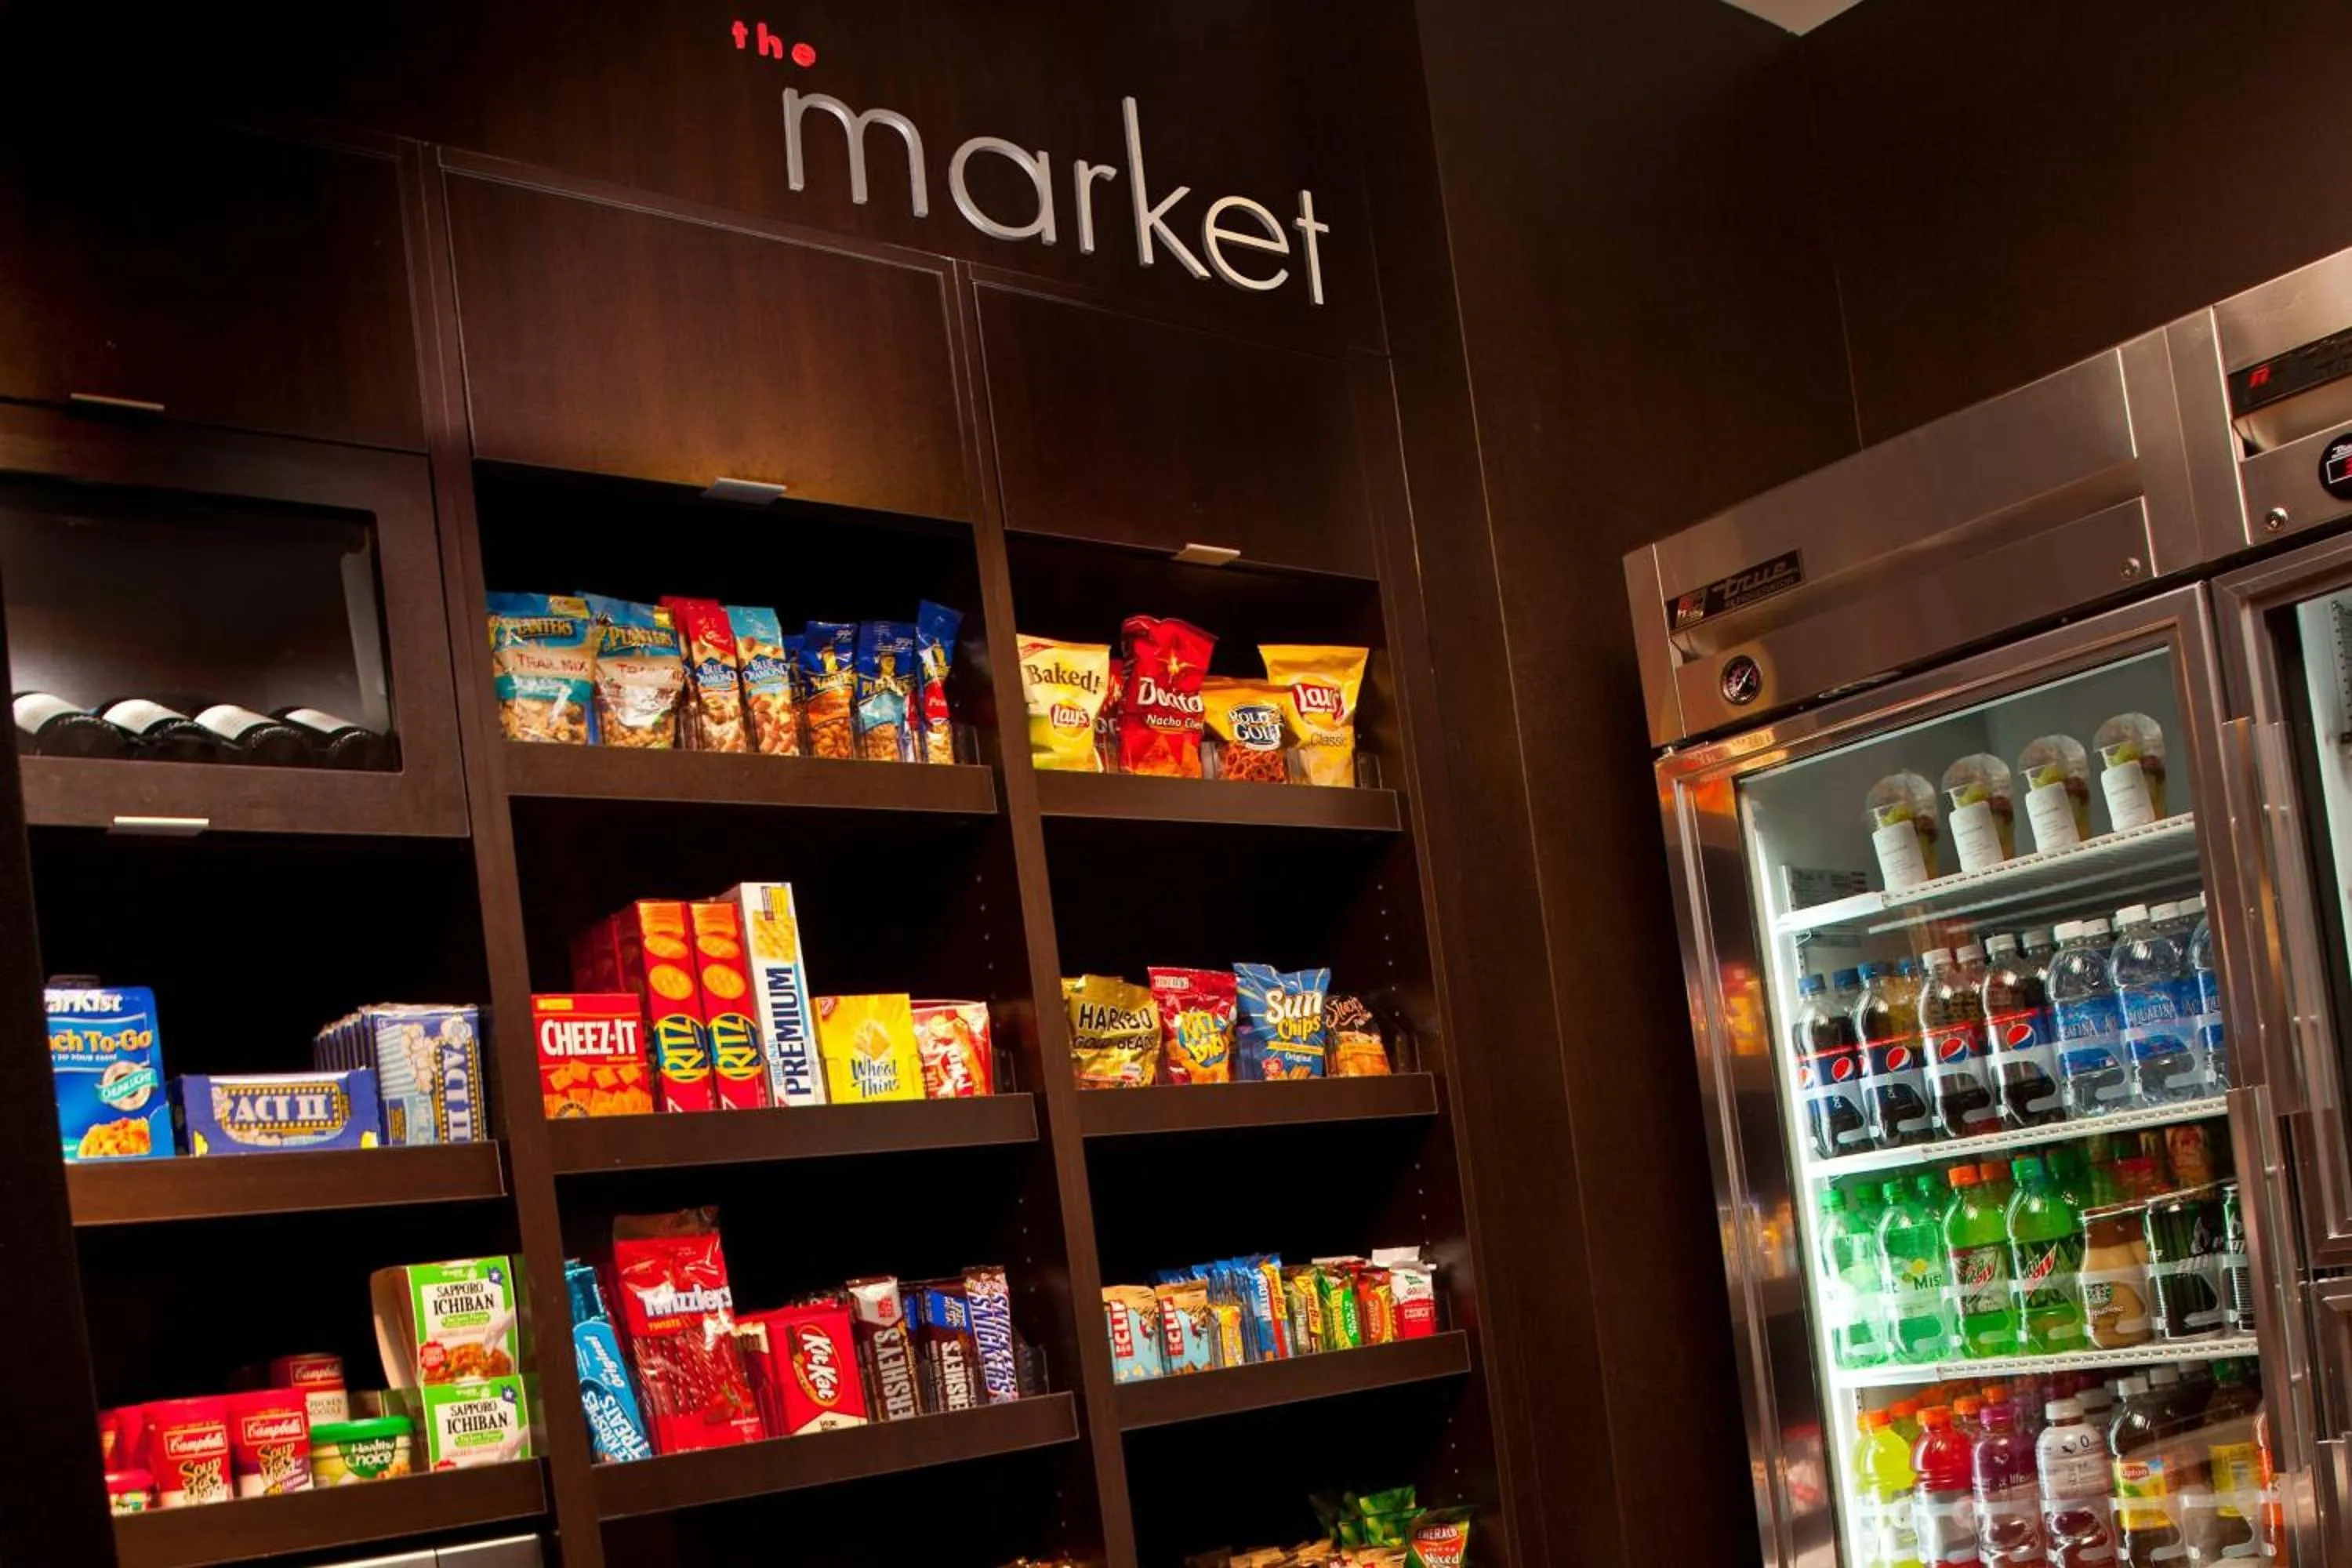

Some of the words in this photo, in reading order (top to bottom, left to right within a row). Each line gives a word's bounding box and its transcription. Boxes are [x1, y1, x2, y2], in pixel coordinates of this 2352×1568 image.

[731, 20, 816, 68] the
[782, 87, 1330, 305] market
[1023, 662, 1099, 695] Baked!
[1137, 677, 1205, 713] Dorito
[1146, 713, 1182, 728] Nacho
[1265, 989, 1323, 1024] Sun
[540, 1017, 637, 1057] CHEEZ-IT
[659, 1017, 706, 1073] RITZ
[712, 1016, 759, 1071] RITZ
[765, 967, 811, 1095] PREMIUM
[1276, 1014, 1322, 1042] Chips
[444, 1047, 470, 1105] ACT
[851, 1058, 898, 1080] Wheat
[851, 1079, 901, 1098] Thins
[235, 1094, 285, 1121] ACT
[296, 1094, 329, 1119] II
[433, 1293, 495, 1316] ICHIBAN
[437, 1281, 485, 1298] SAPPORO
[1109, 1300, 1131, 1344] CLIF
[1163, 1300, 1181, 1344] CLIF
[967, 1294, 1011, 1394] SNICKERS
[873, 1327, 916, 1420] ERSHEY'S
[446, 1410, 508, 1436] ICHIBAN
[450, 1400, 498, 1417] SAPPORO
